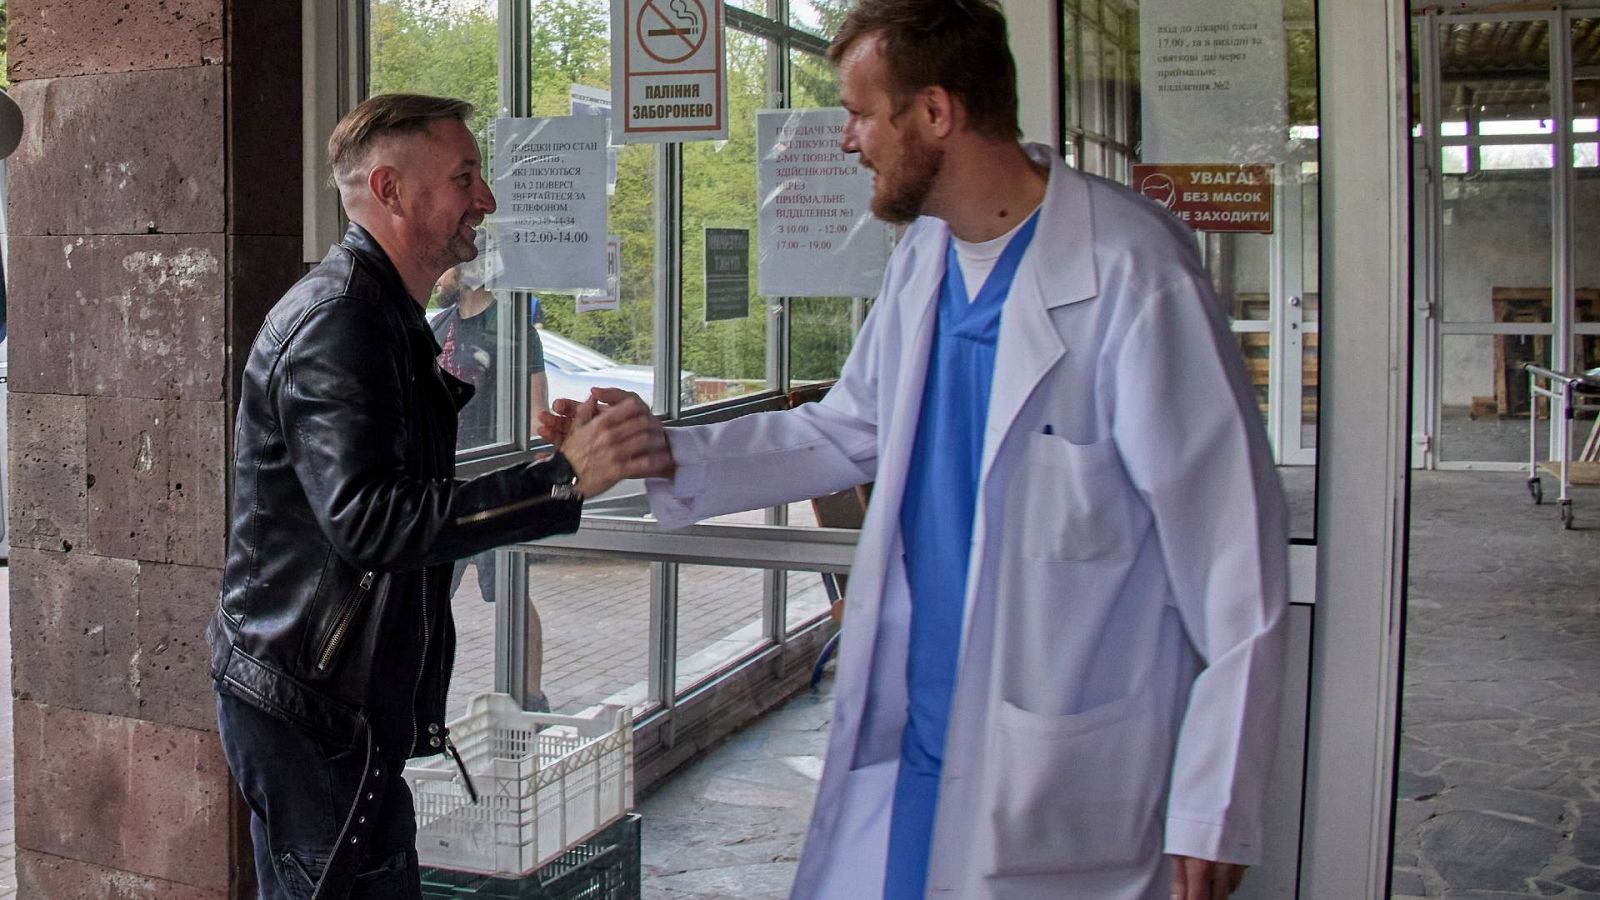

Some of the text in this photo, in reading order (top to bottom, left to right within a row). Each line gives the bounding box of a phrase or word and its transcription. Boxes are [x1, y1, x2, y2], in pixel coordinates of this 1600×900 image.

[645, 83, 700, 99] ПАЛІННЯ
[633, 103, 713, 120] ЗАБОРОНЕНО
[553, 142, 571, 152] ПРО
[572, 142, 597, 151] СТАН
[795, 139, 841, 149] ЛІКУЮТЬ
[803, 152, 846, 162] ПОВЕРСІ
[512, 167, 581, 176] ЯКІ ЛІКУЮТЬСЯ
[1190, 171, 1254, 185] УВАГА!
[514, 181, 527, 190] НА
[529, 180, 534, 189] 2
[574, 191, 586, 200] ЗА
[776, 193, 846, 204] ПРИЙМАЛЬНЕ
[1183, 192, 1262, 202] БЕЗ МАСОК
[776, 208, 854, 219] ВІДДІЛЕННЯ №1
[1194, 211, 1270, 222] ЗАХОДИТИ
[786, 225, 809, 233] 10.00
[825, 225, 848, 233] 12.00
[524, 231, 588, 243] 12.00-14.00
[776, 240, 799, 250] 17.00
[809, 240, 832, 250] 19.00
